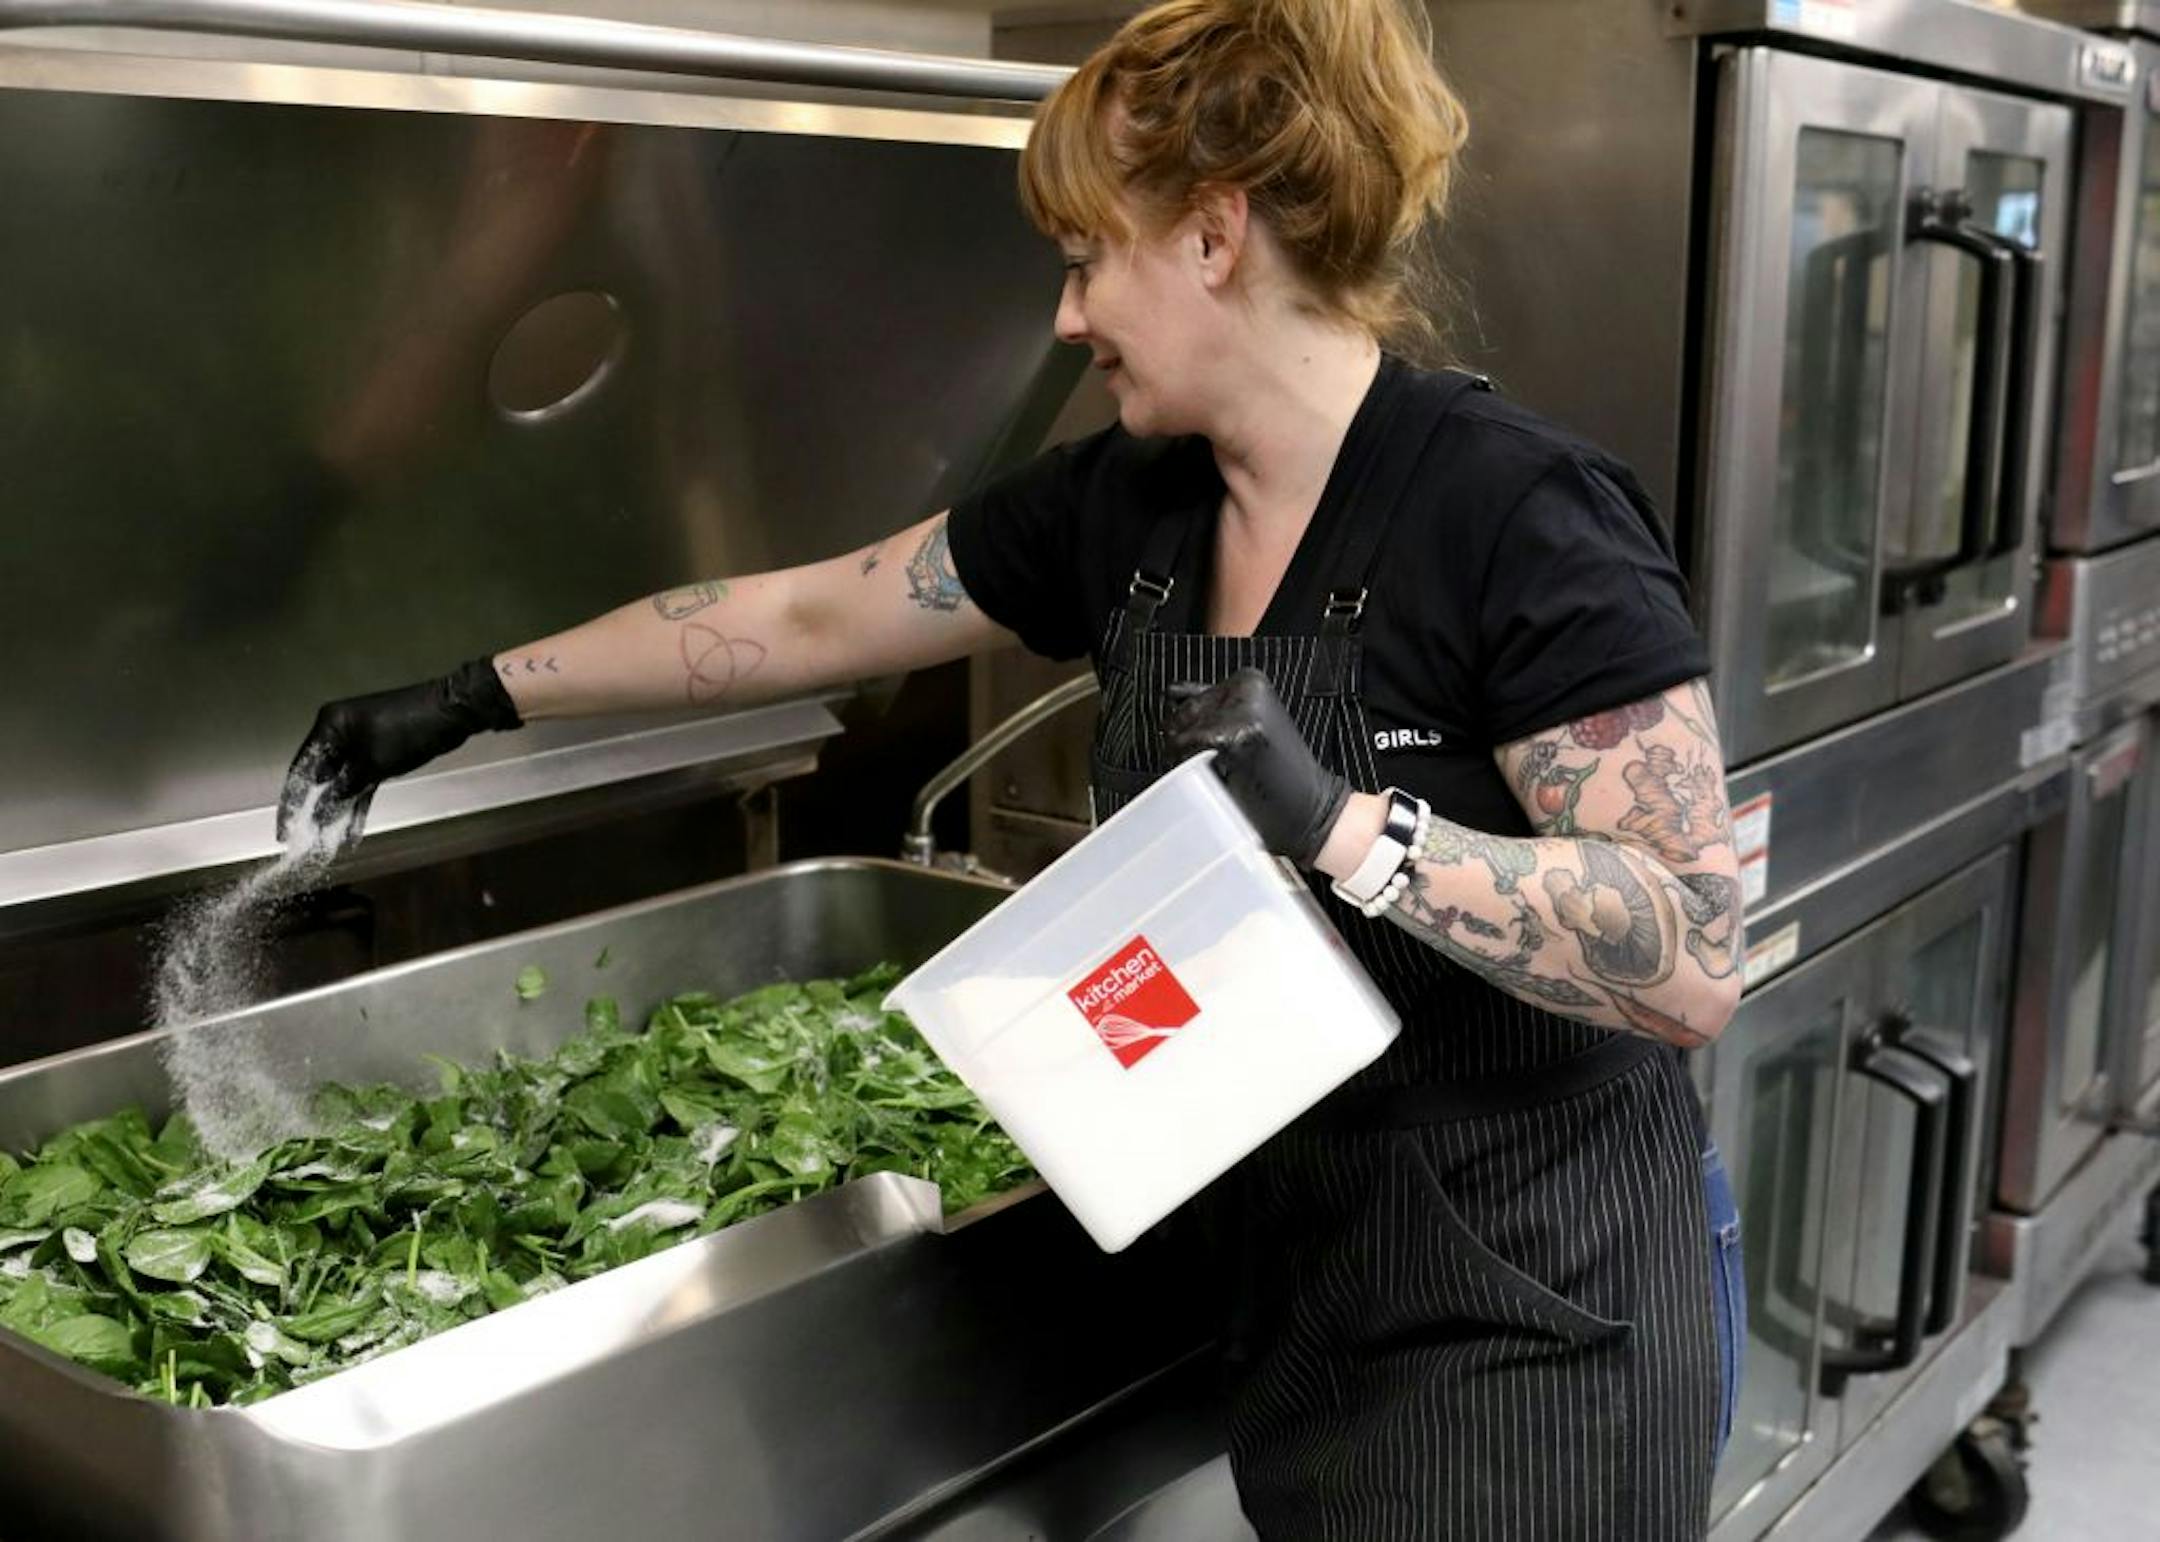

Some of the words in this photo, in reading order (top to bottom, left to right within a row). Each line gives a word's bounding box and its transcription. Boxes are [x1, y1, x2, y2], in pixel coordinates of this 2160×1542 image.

[1374, 729, 1442, 750] GIRLS
[1075, 948, 1154, 1013] kitchen
[1113, 961, 1163, 1004] market
